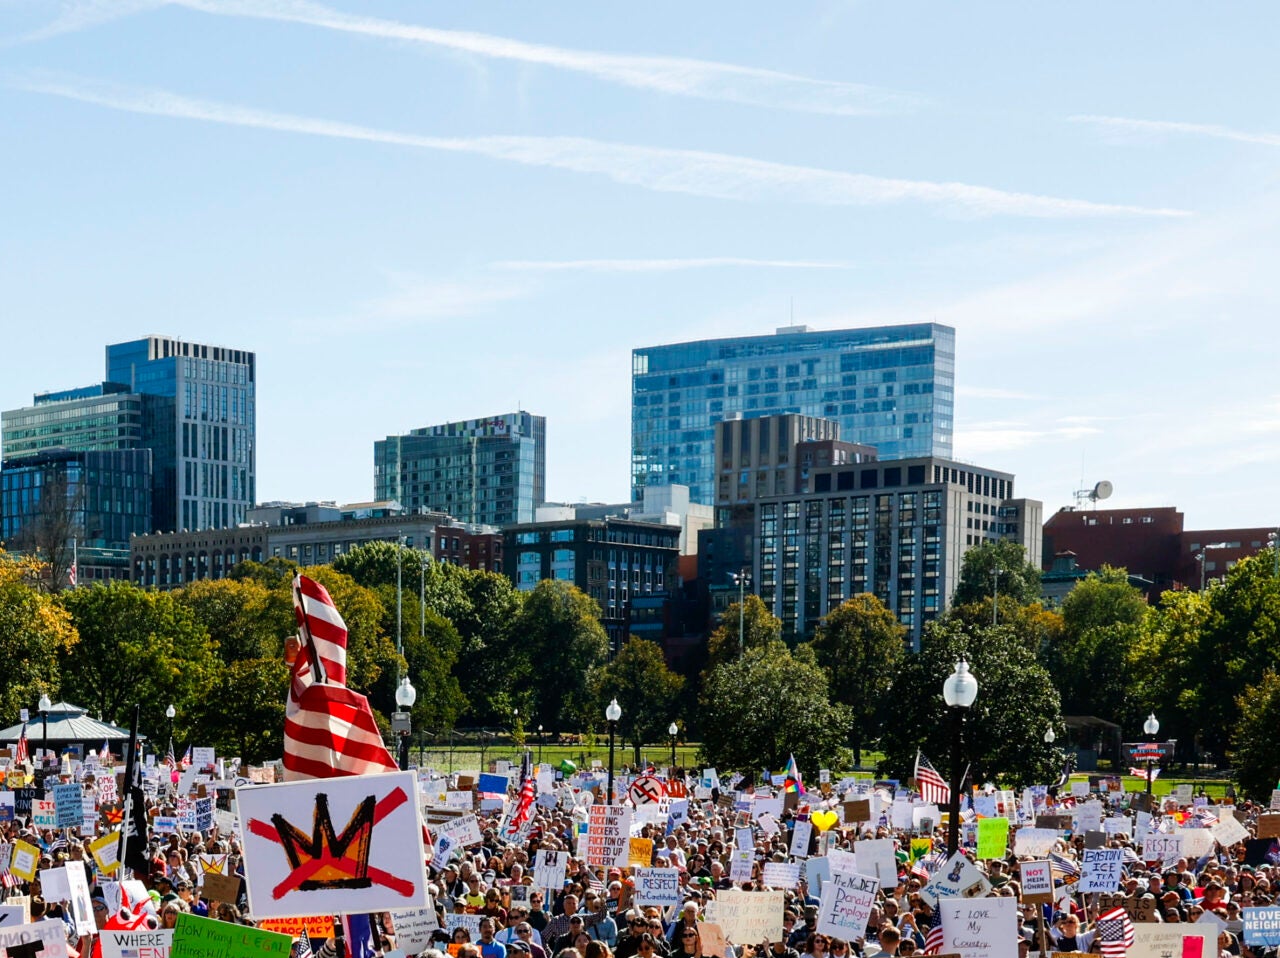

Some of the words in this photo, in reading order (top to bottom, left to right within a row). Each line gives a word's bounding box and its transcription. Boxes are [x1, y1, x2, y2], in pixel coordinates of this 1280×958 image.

[590, 805, 606, 816] FUCK
[610, 806, 624, 816] THIS
[590, 816, 618, 826] FUCKING
[589, 826, 620, 836] FUCKER'S
[588, 836, 616, 846] FUCKTON
[617, 837, 626, 846] OF
[1145, 839, 1181, 852] RESIST
[588, 846, 612, 856] FUCKED
[612, 847, 622, 856] UP
[1084, 850, 1121, 862] BOSTON
[587, 856, 616, 866] FUCKERY
[1093, 863, 1116, 872] ICE
[637, 870, 650, 878] Real
[651, 870, 675, 878] Americans
[1025, 869, 1044, 877] NOT
[643, 879, 676, 890] RESPECT
[637, 891, 647, 900] The
[1102, 899, 1130, 909] ICE
[1133, 900, 1150, 909] IS
[954, 910, 960, 919] I
[968, 910, 989, 919] LOVE
[1245, 911, 1280, 920] #LOVE
[968, 922, 981, 933] My
[114, 933, 164, 947] WHERE
